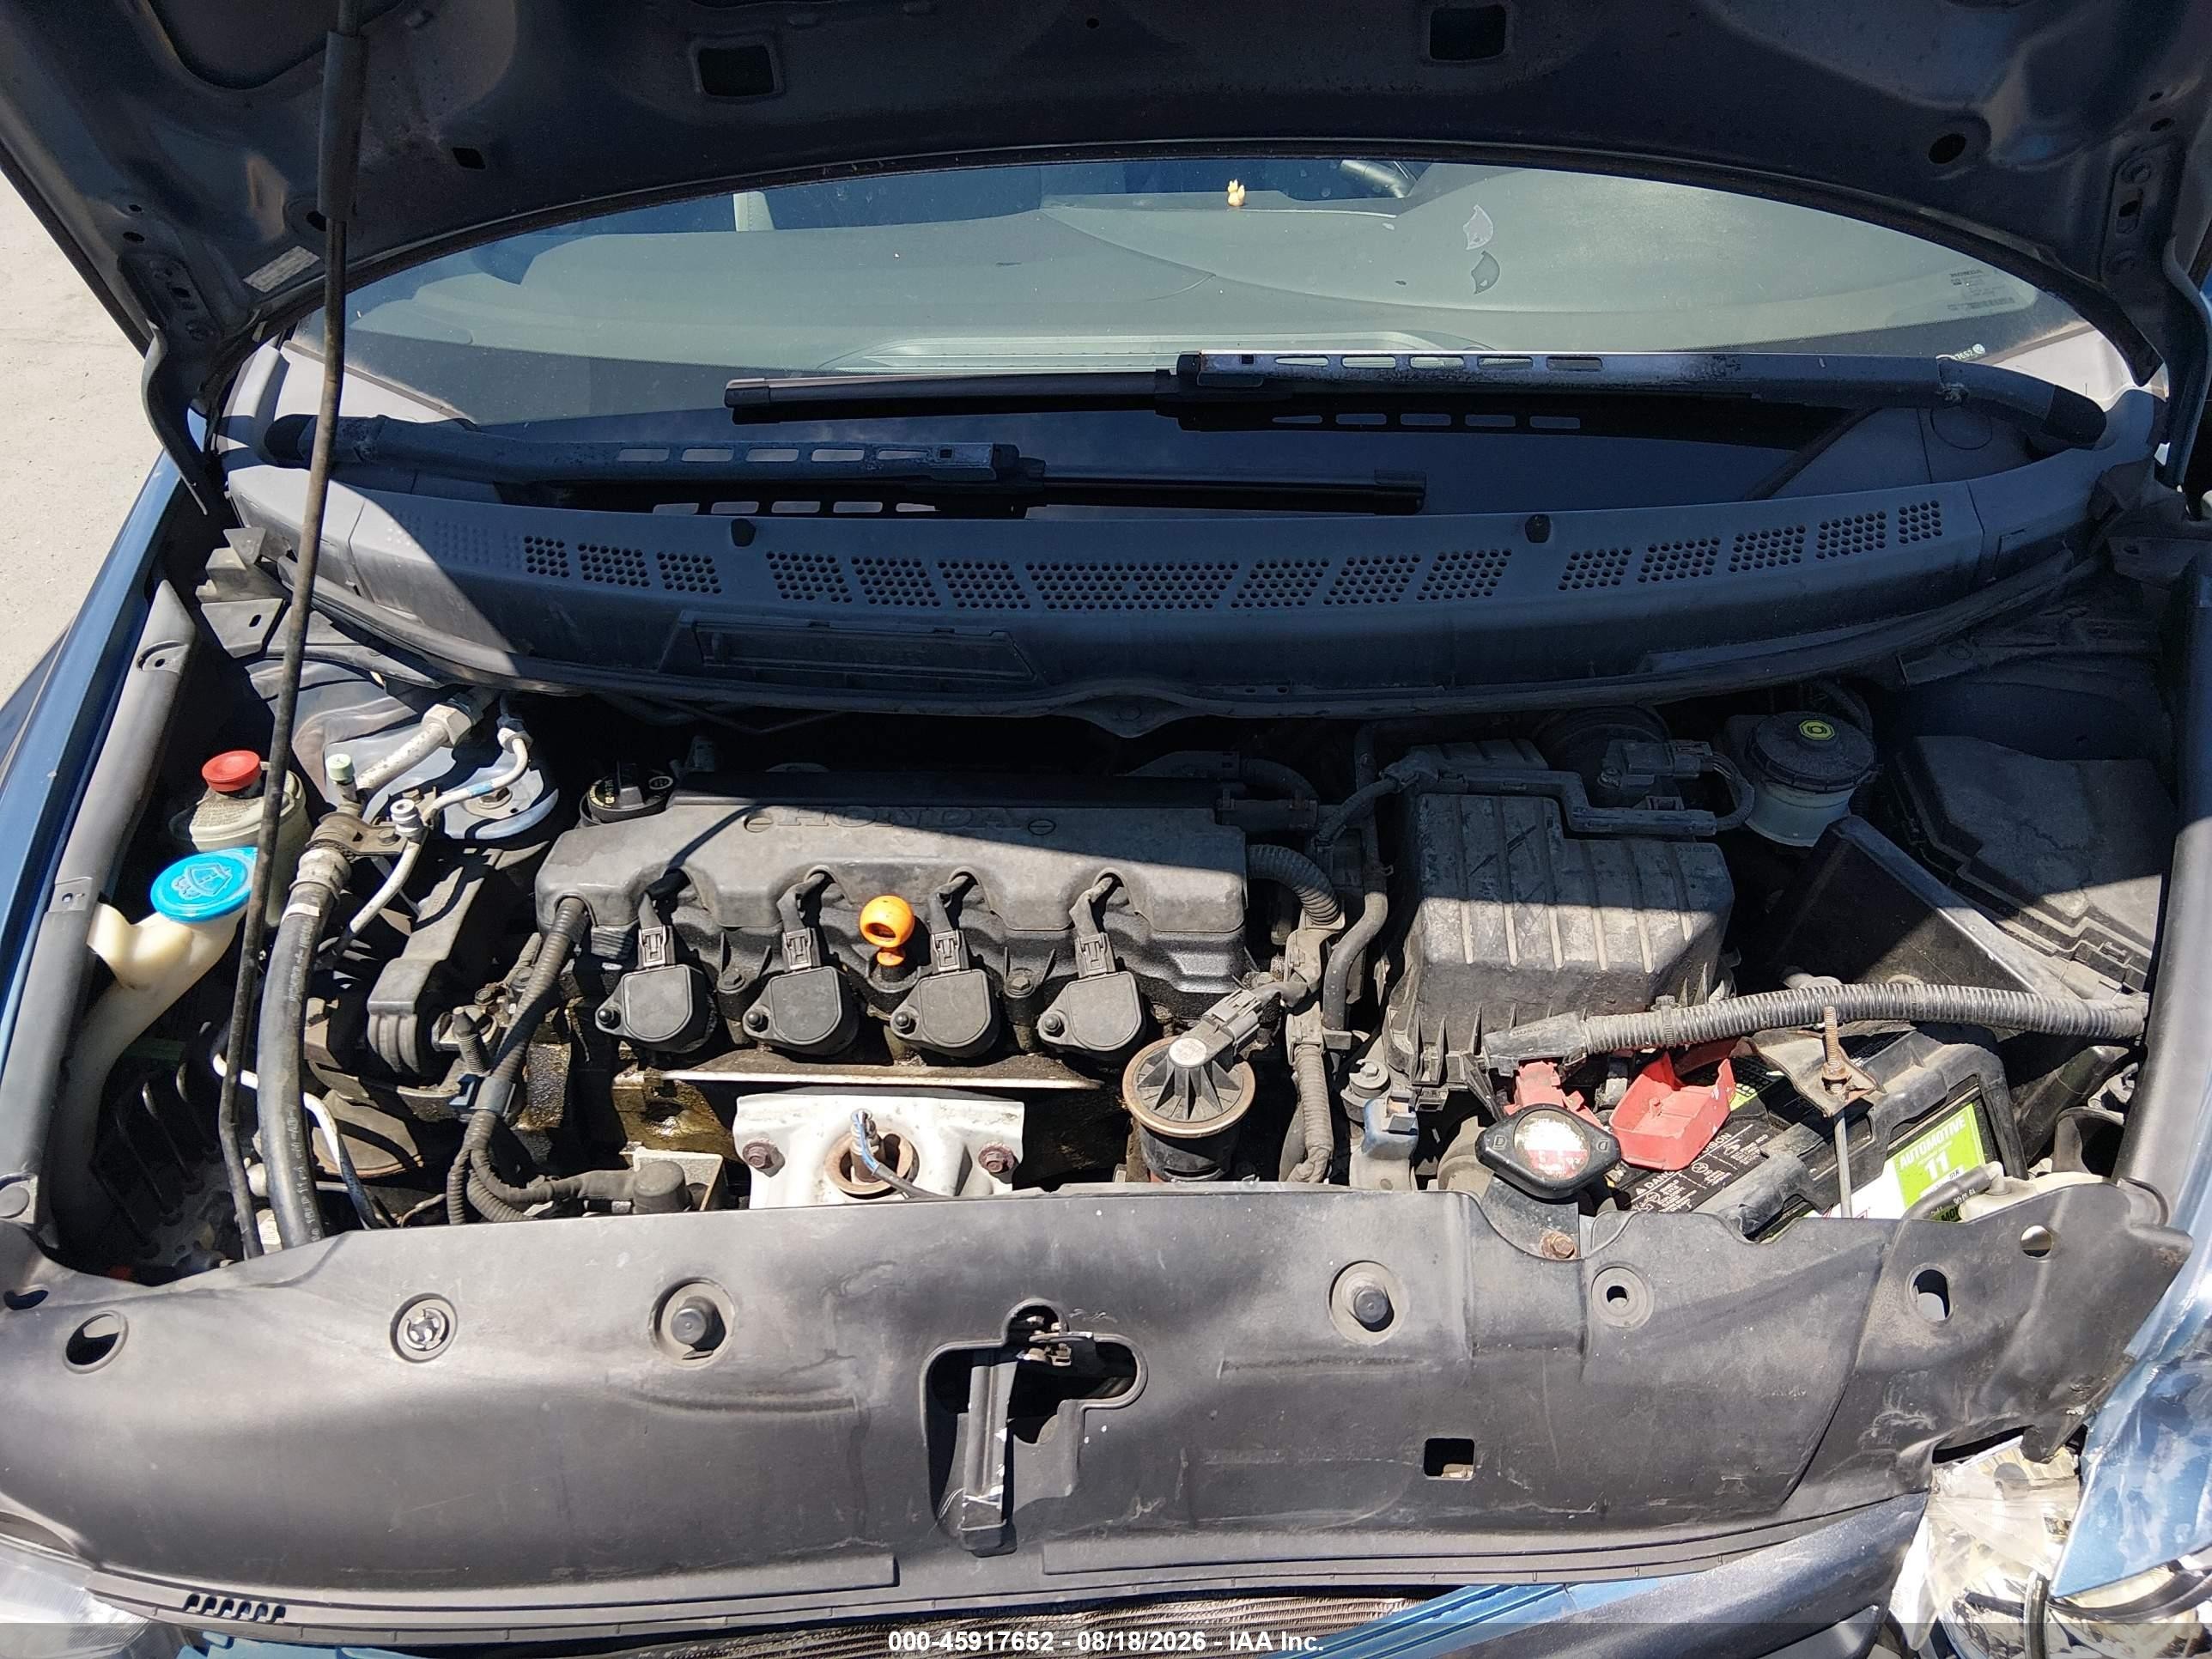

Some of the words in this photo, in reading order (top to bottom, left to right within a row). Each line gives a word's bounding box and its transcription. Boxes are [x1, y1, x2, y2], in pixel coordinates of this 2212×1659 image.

[776, 805, 1022, 829] HONDA
[1899, 1117, 1966, 1170] AUTOMOTIVE
[1924, 1150, 1950, 1181] 11
